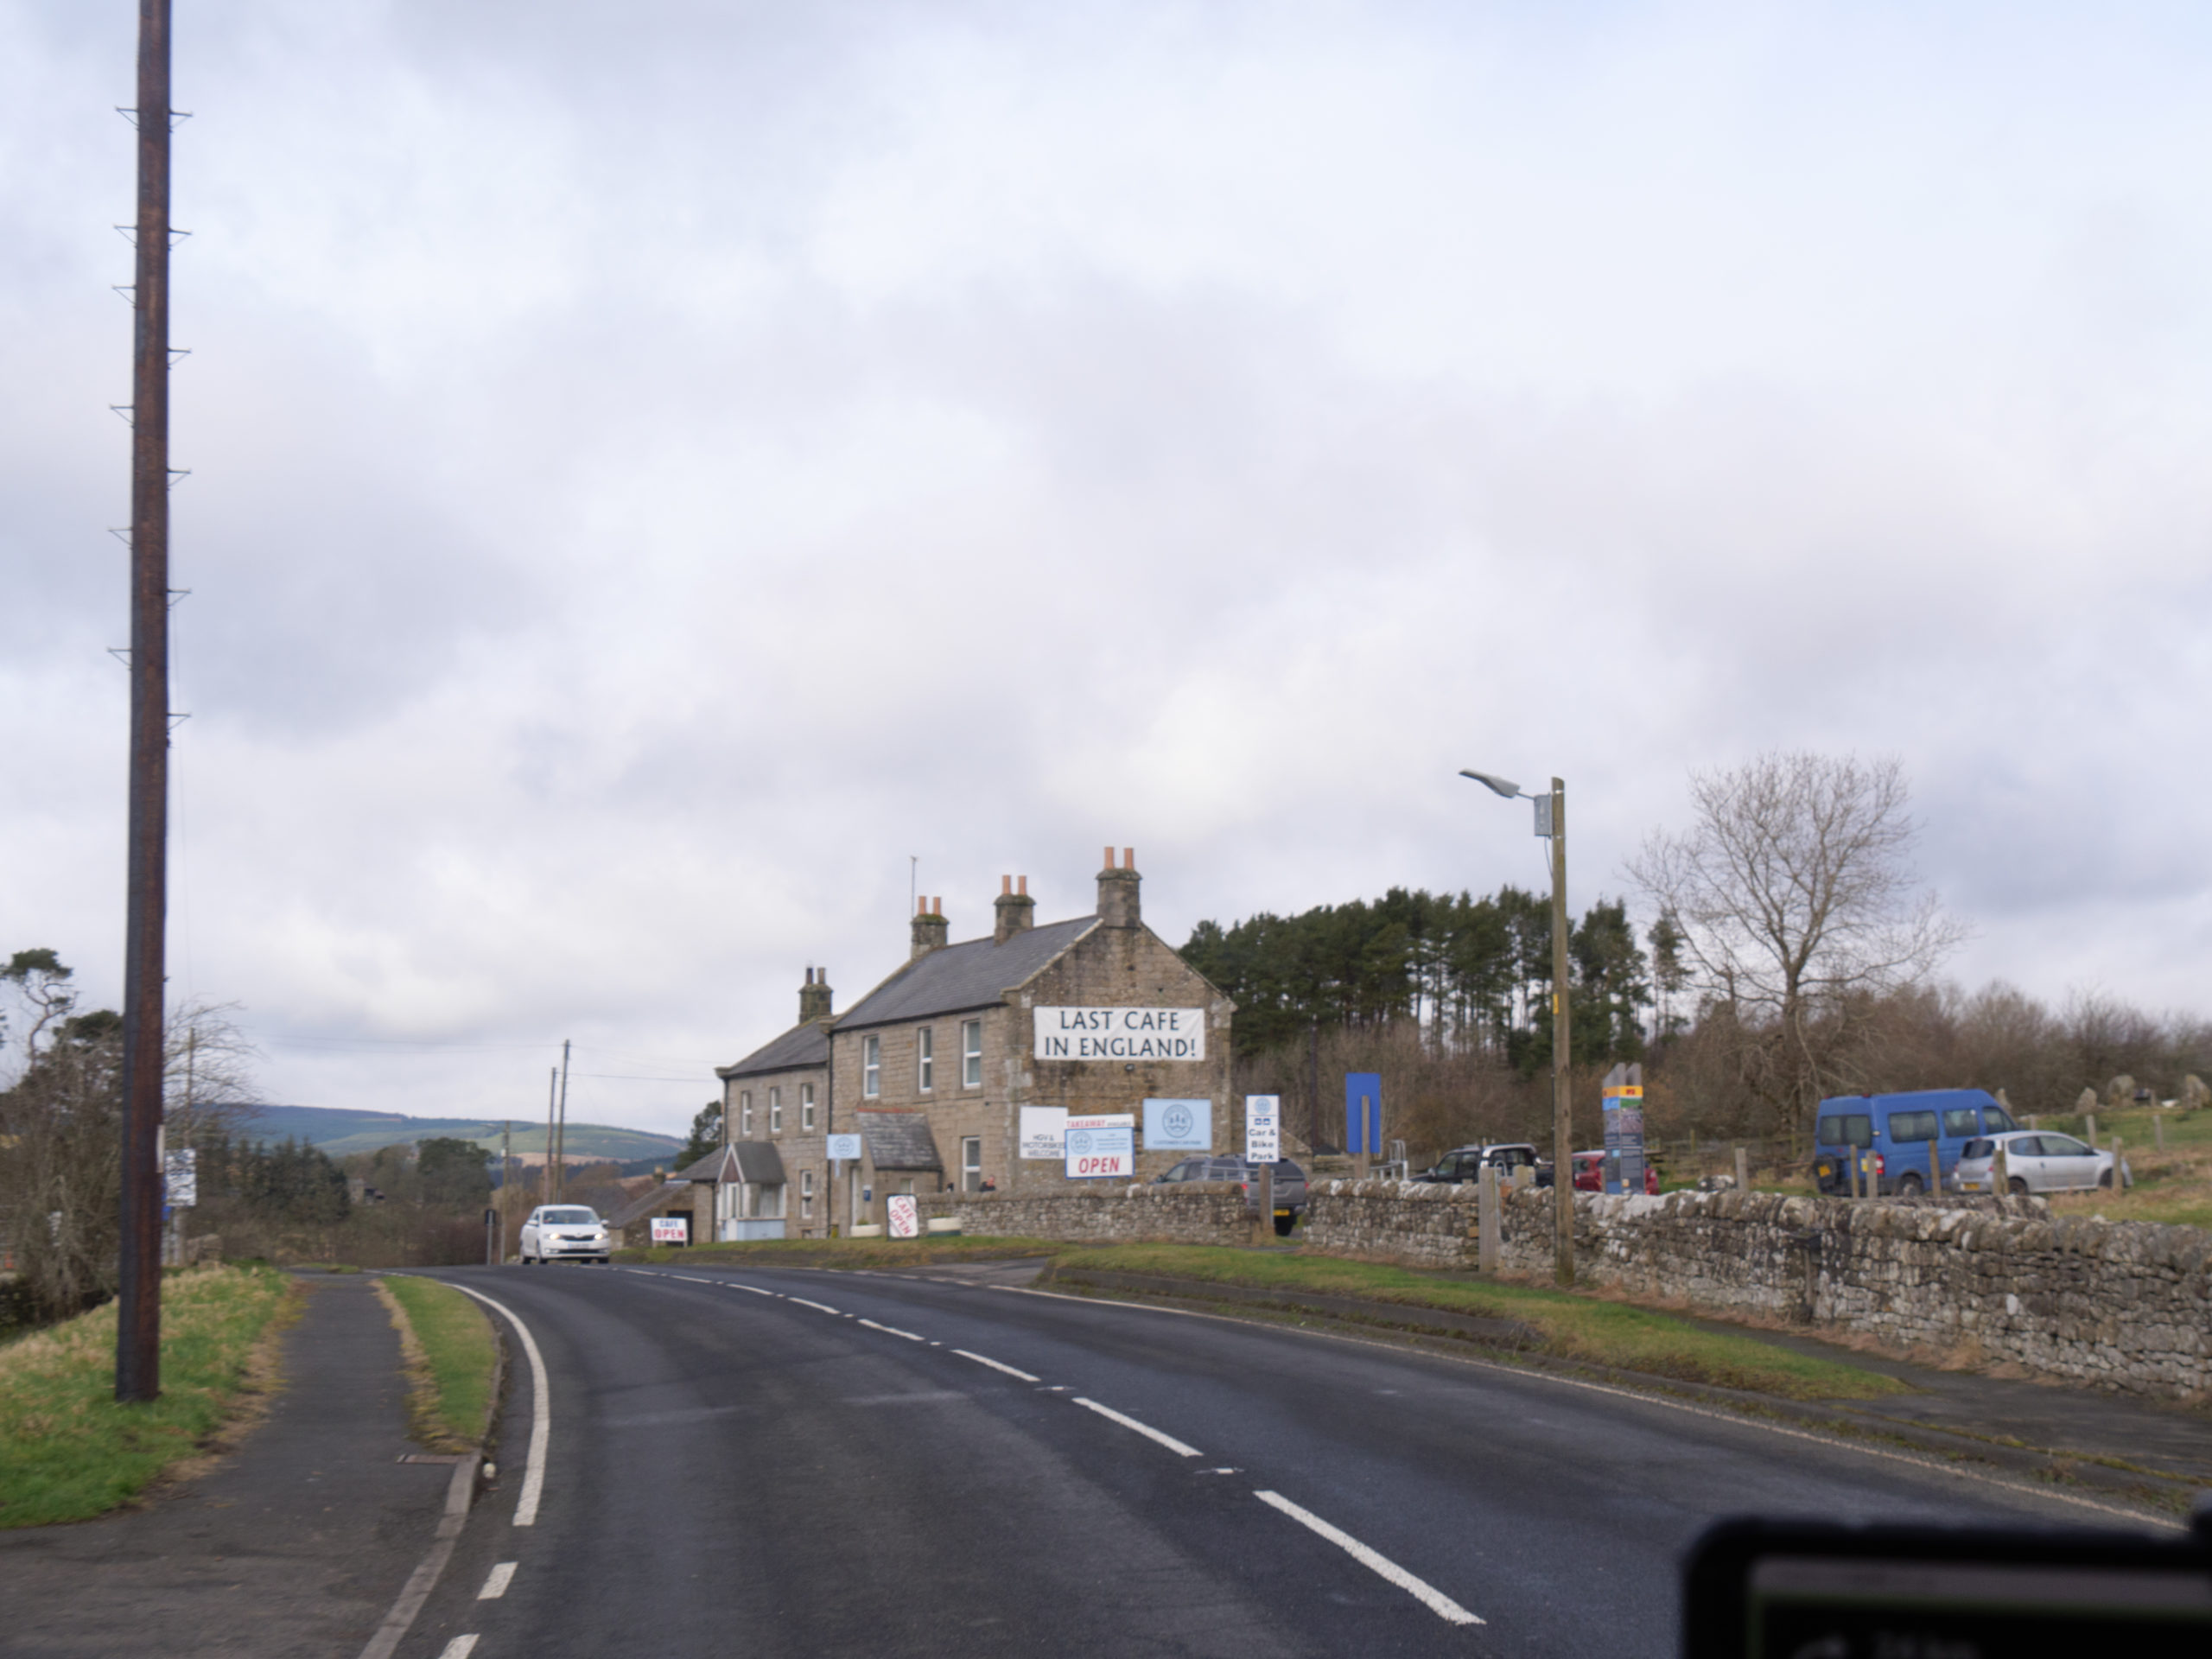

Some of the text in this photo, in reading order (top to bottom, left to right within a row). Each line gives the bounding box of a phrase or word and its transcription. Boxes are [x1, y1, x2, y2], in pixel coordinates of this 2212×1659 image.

[1060, 1010, 1179, 1031] LAST CAFE
[1045, 1037, 1196, 1058] IN ENGLAND!
[1066, 1119, 1105, 1128] TAKEAWAY
[1249, 1128, 1276, 1137] Car &
[1078, 1156, 1120, 1174] OPEN
[895, 1197, 915, 1219] CAFE
[659, 1219, 678, 1228] CAFE
[890, 1209, 912, 1235] OPEN
[654, 1229, 684, 1238] OPEN
